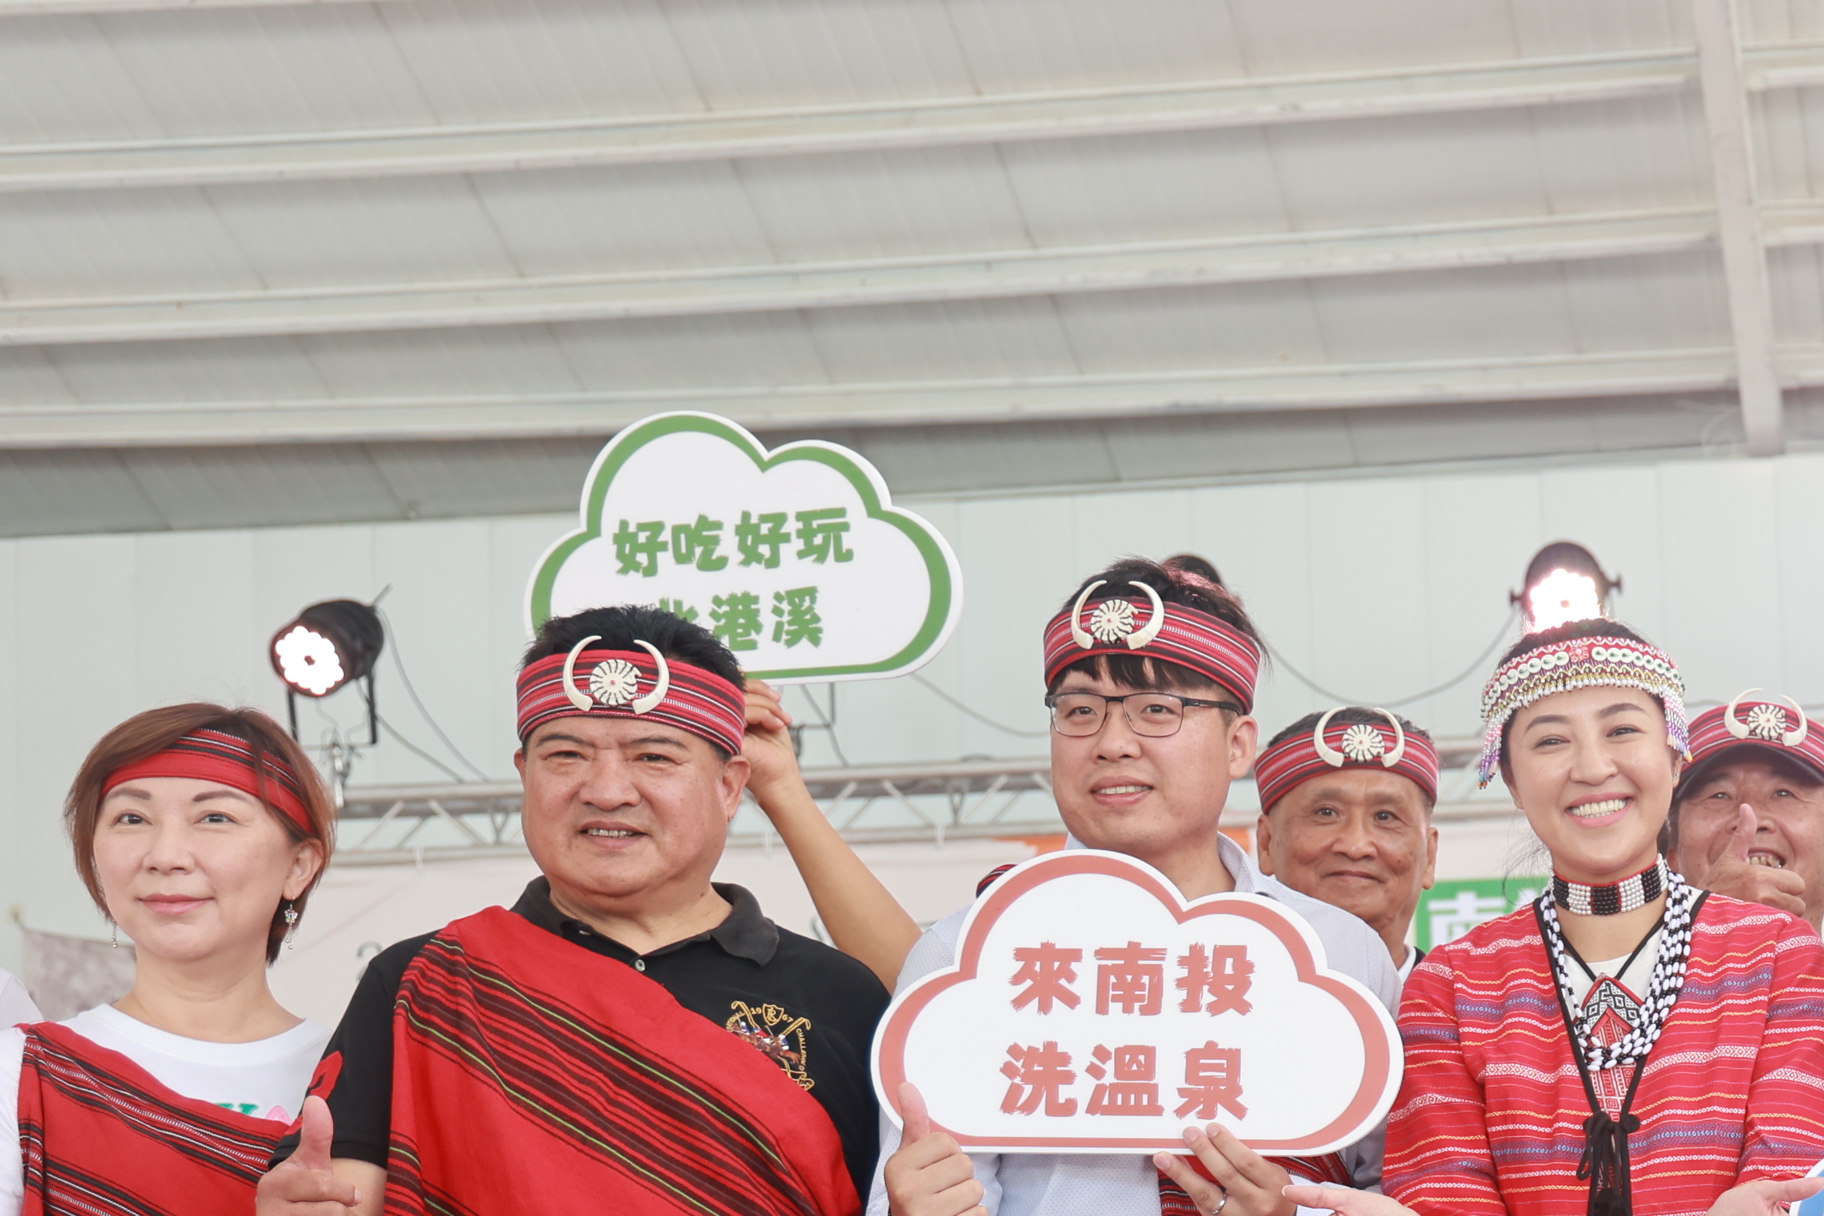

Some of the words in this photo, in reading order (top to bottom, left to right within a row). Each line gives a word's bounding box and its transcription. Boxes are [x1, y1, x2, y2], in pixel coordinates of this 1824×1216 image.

[612, 506, 854, 577] 好吃好玩
[1009, 940, 1255, 1017] 來南投
[999, 1040, 1249, 1121] 洗溫泉
